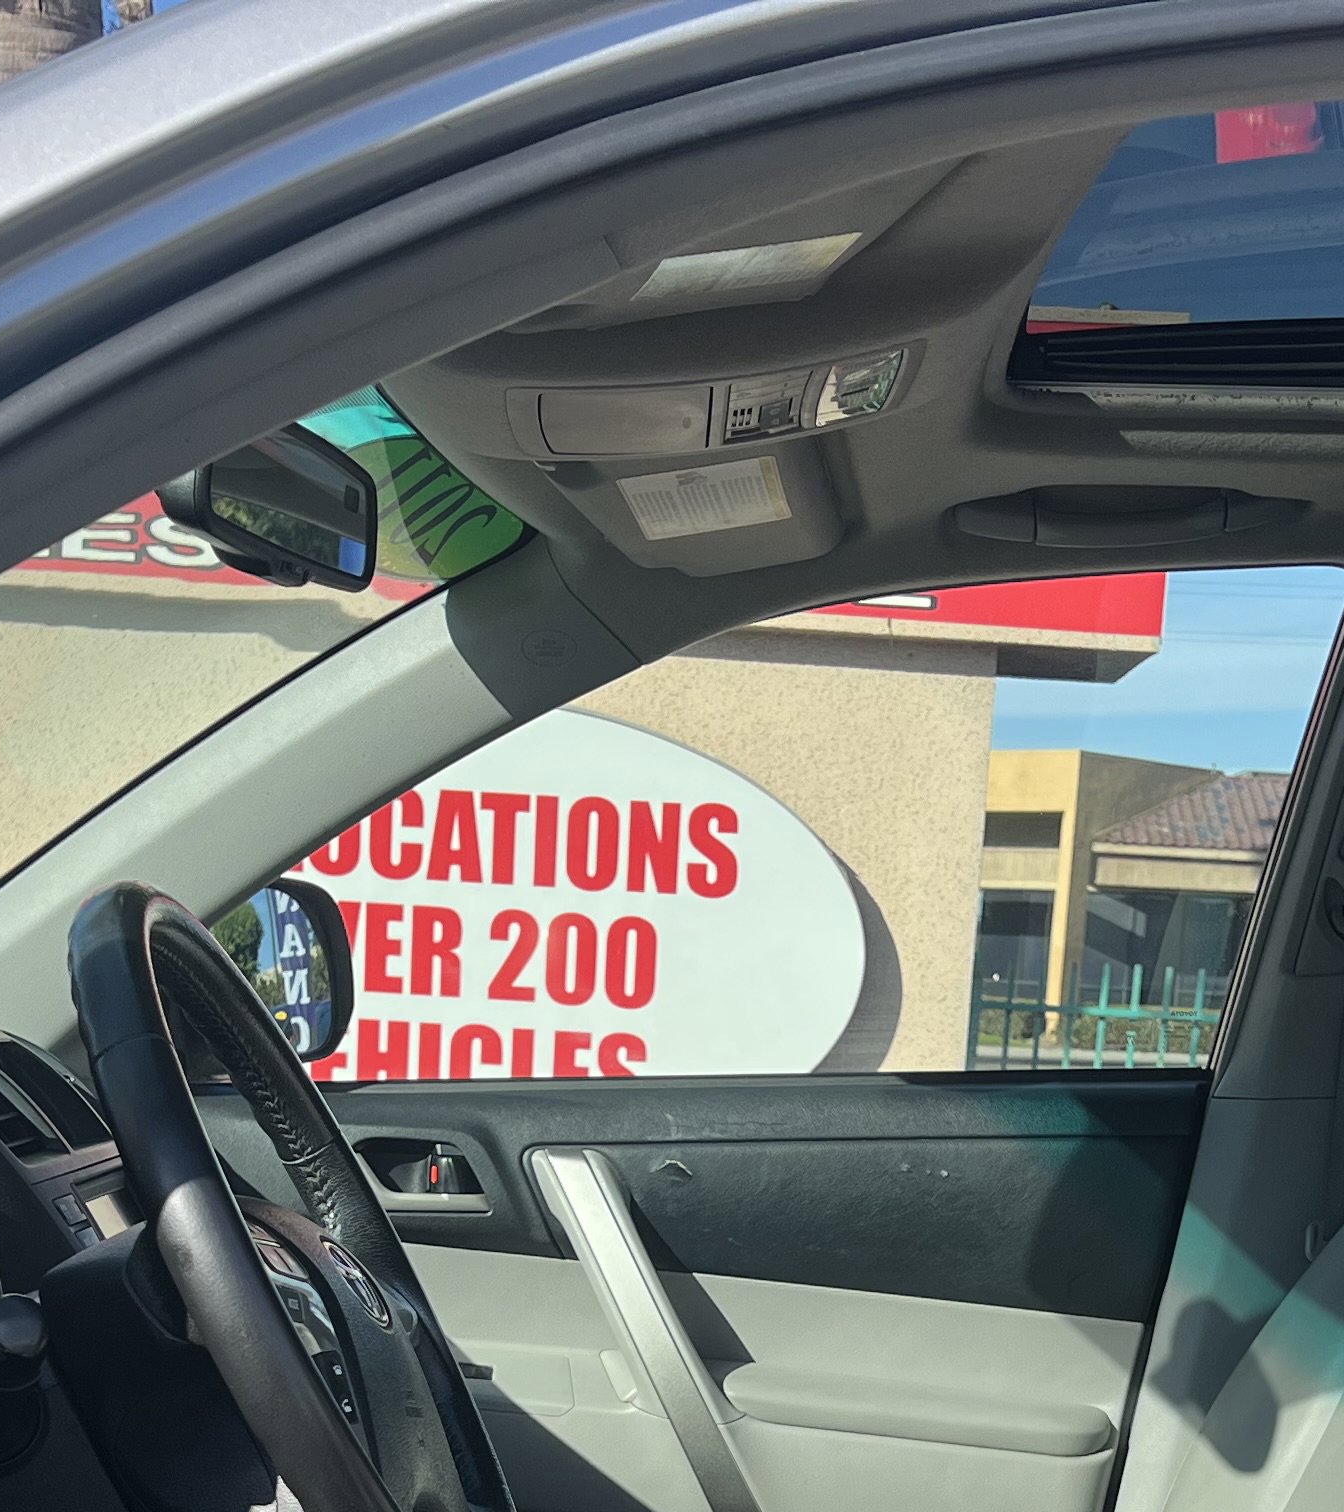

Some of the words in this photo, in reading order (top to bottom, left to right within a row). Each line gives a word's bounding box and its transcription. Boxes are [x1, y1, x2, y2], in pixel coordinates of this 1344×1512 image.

[29, 510, 224, 571] ES
[290, 789, 739, 899] OCATIONS
[488, 909, 657, 1009] 200
